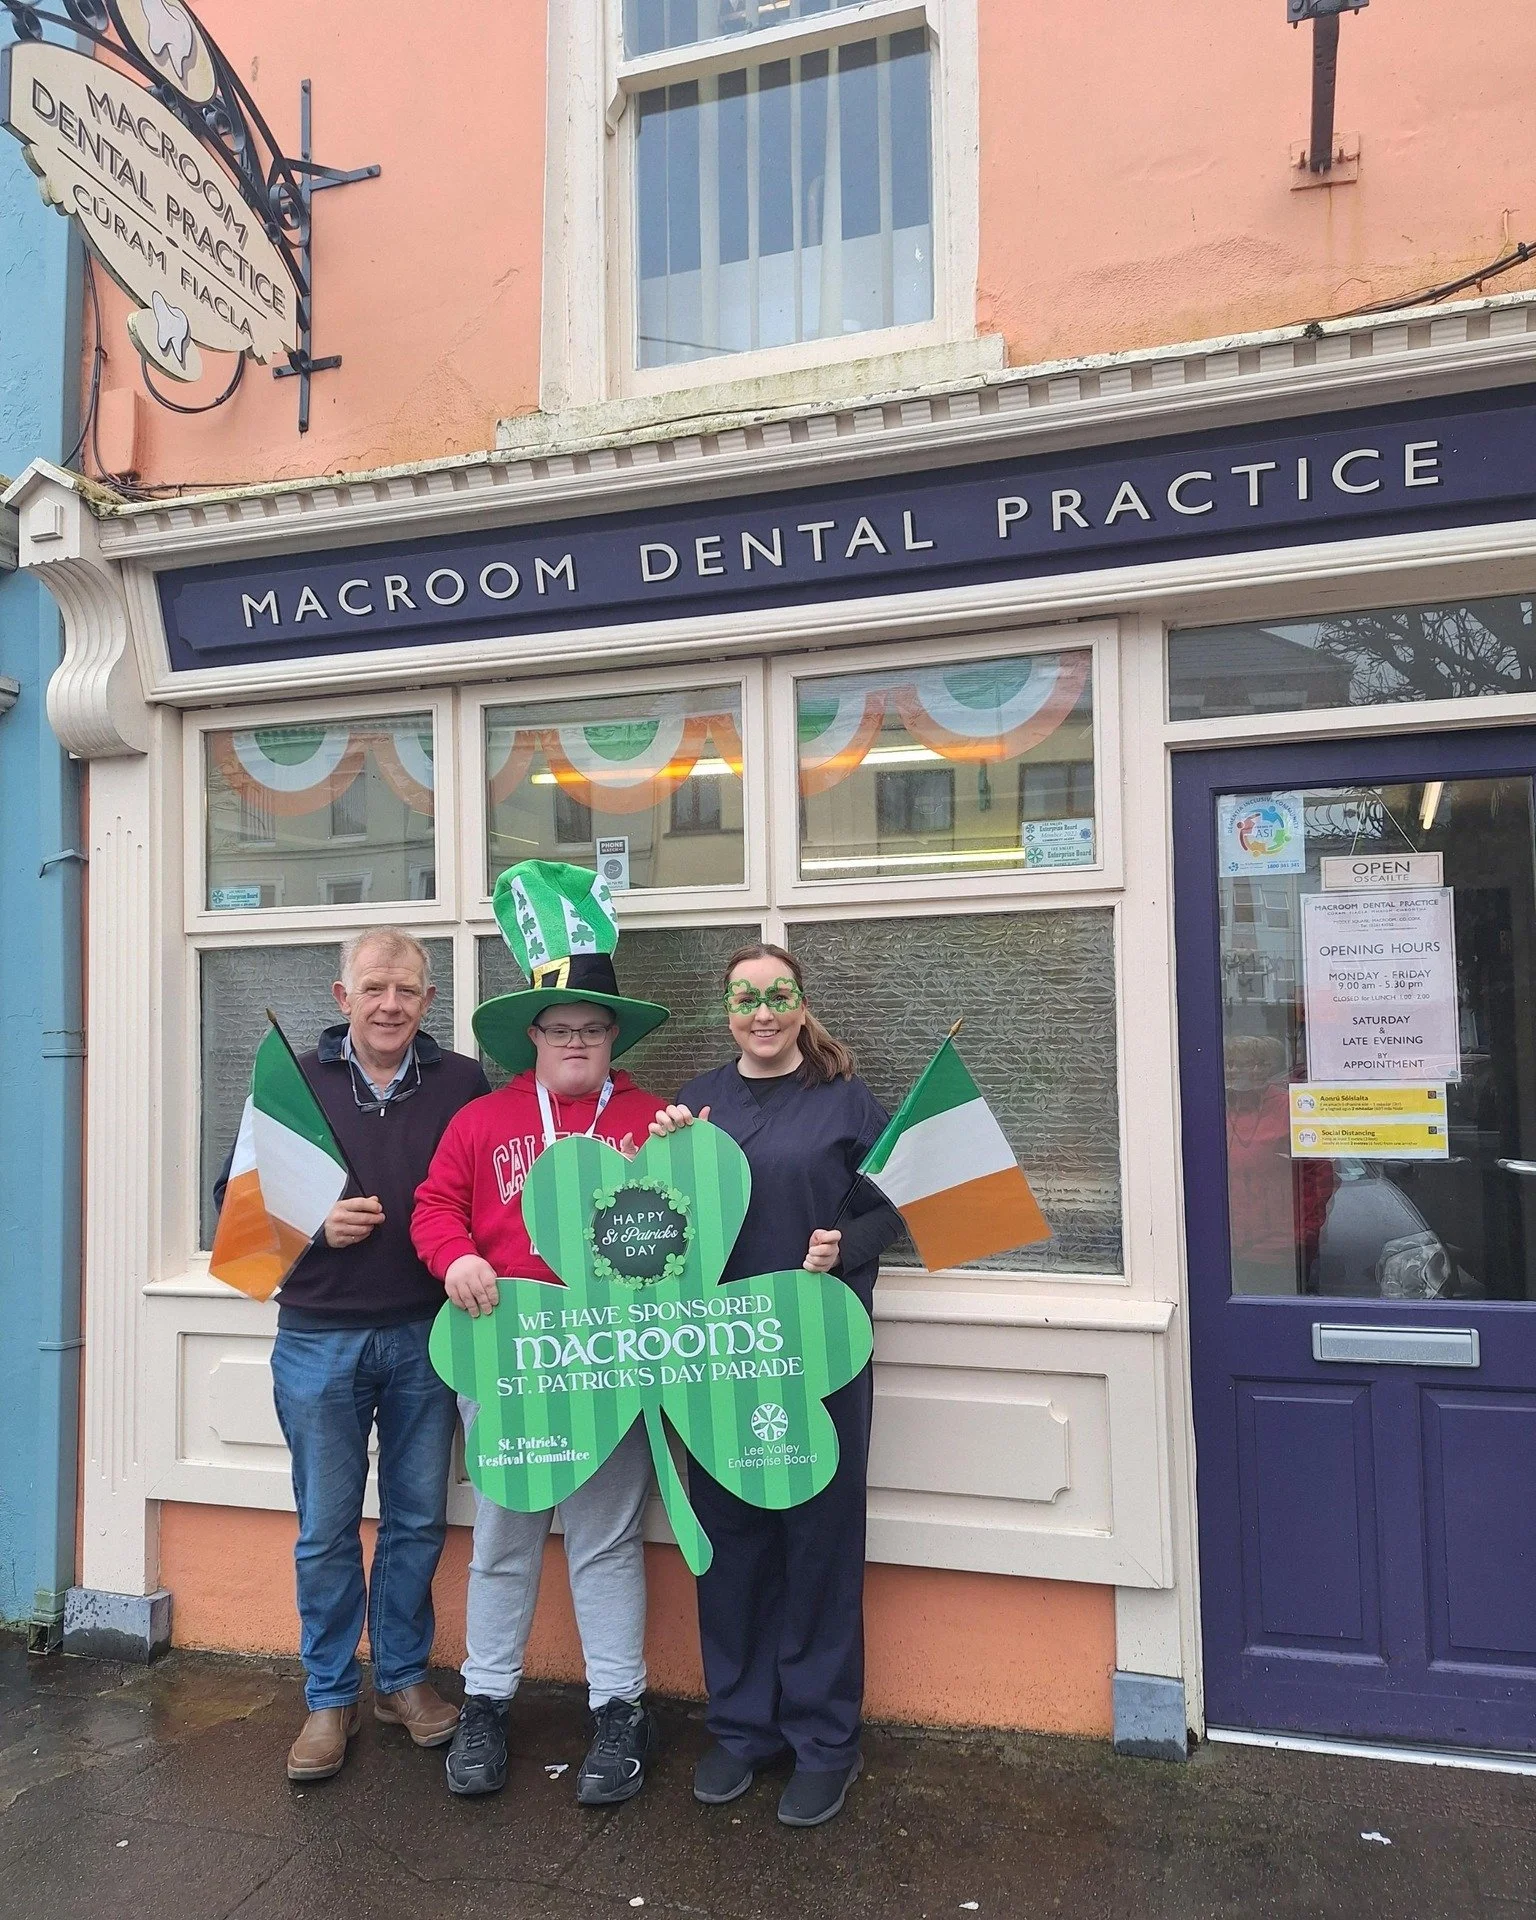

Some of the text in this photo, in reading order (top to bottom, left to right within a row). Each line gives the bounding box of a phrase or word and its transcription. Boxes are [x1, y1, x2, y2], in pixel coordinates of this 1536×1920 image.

[85, 83, 249, 246] MACROOM
[32, 77, 286, 320] DENTAL PRACTICE
[72, 183, 252, 343] CÚRAM FIACLA
[241, 440, 1439, 628] MACROOM DENTAL PRACTICE
[1255, 829, 1273, 838] ASI
[1352, 861, 1410, 875] OPEN
[1354, 874, 1409, 883] OSCAILTE
[1314, 899, 1439, 911] MACROOM DENTAL PRACTICE
[1320, 941, 1441, 956] OPENING HOURS
[1329, 971, 1379, 981] MONDAY
[1392, 970, 1431, 979] FRIDAY
[1339, 981, 1359, 990] 9.00
[1385, 980, 1405, 989] 5.30
[1408, 981, 1423, 990] pm
[1352, 1015, 1411, 1025] SATURDAY
[1342, 1035, 1424, 1046] LATE EVENING
[1343, 1060, 1425, 1069] APPOINTMENT
[1341, 1129, 1376, 1137] Distancing
[613, 1210, 664, 1226] HAPPY
[602, 1224, 679, 1245] St Patricks
[625, 1244, 656, 1257] DAY
[518, 1294, 772, 1331] WE HAVE SPONSORED
[512, 1317, 785, 1370] MACROOMS
[496, 1356, 805, 1397] ST. PATRICK'S DAY PARADE
[498, 1434, 568, 1451] St. Patrick's
[744, 1443, 800, 1456] Lee Valley
[477, 1449, 591, 1468] Festival Committee
[728, 1452, 818, 1469] Enterprise Board
